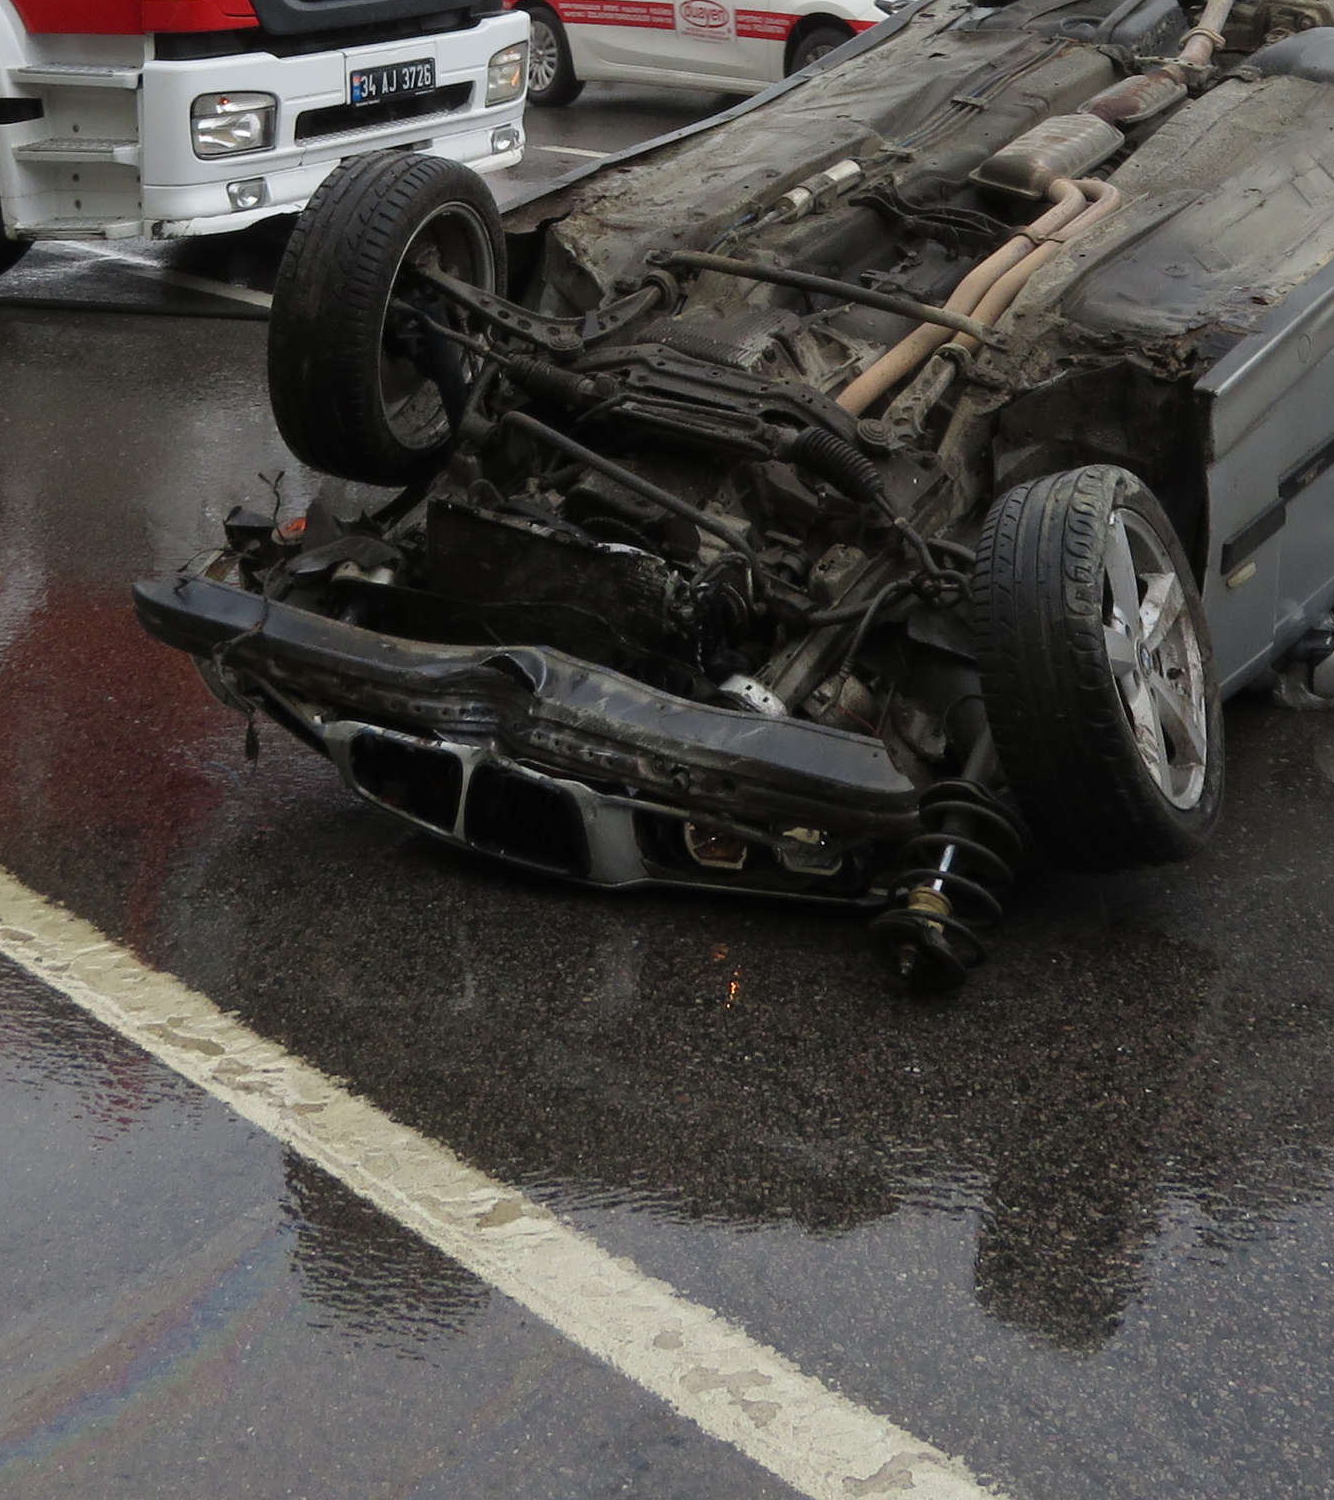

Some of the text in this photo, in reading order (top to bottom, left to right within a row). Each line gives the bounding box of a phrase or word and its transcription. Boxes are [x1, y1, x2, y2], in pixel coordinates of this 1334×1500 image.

[361, 63, 432, 99] 34 AJ 3726
